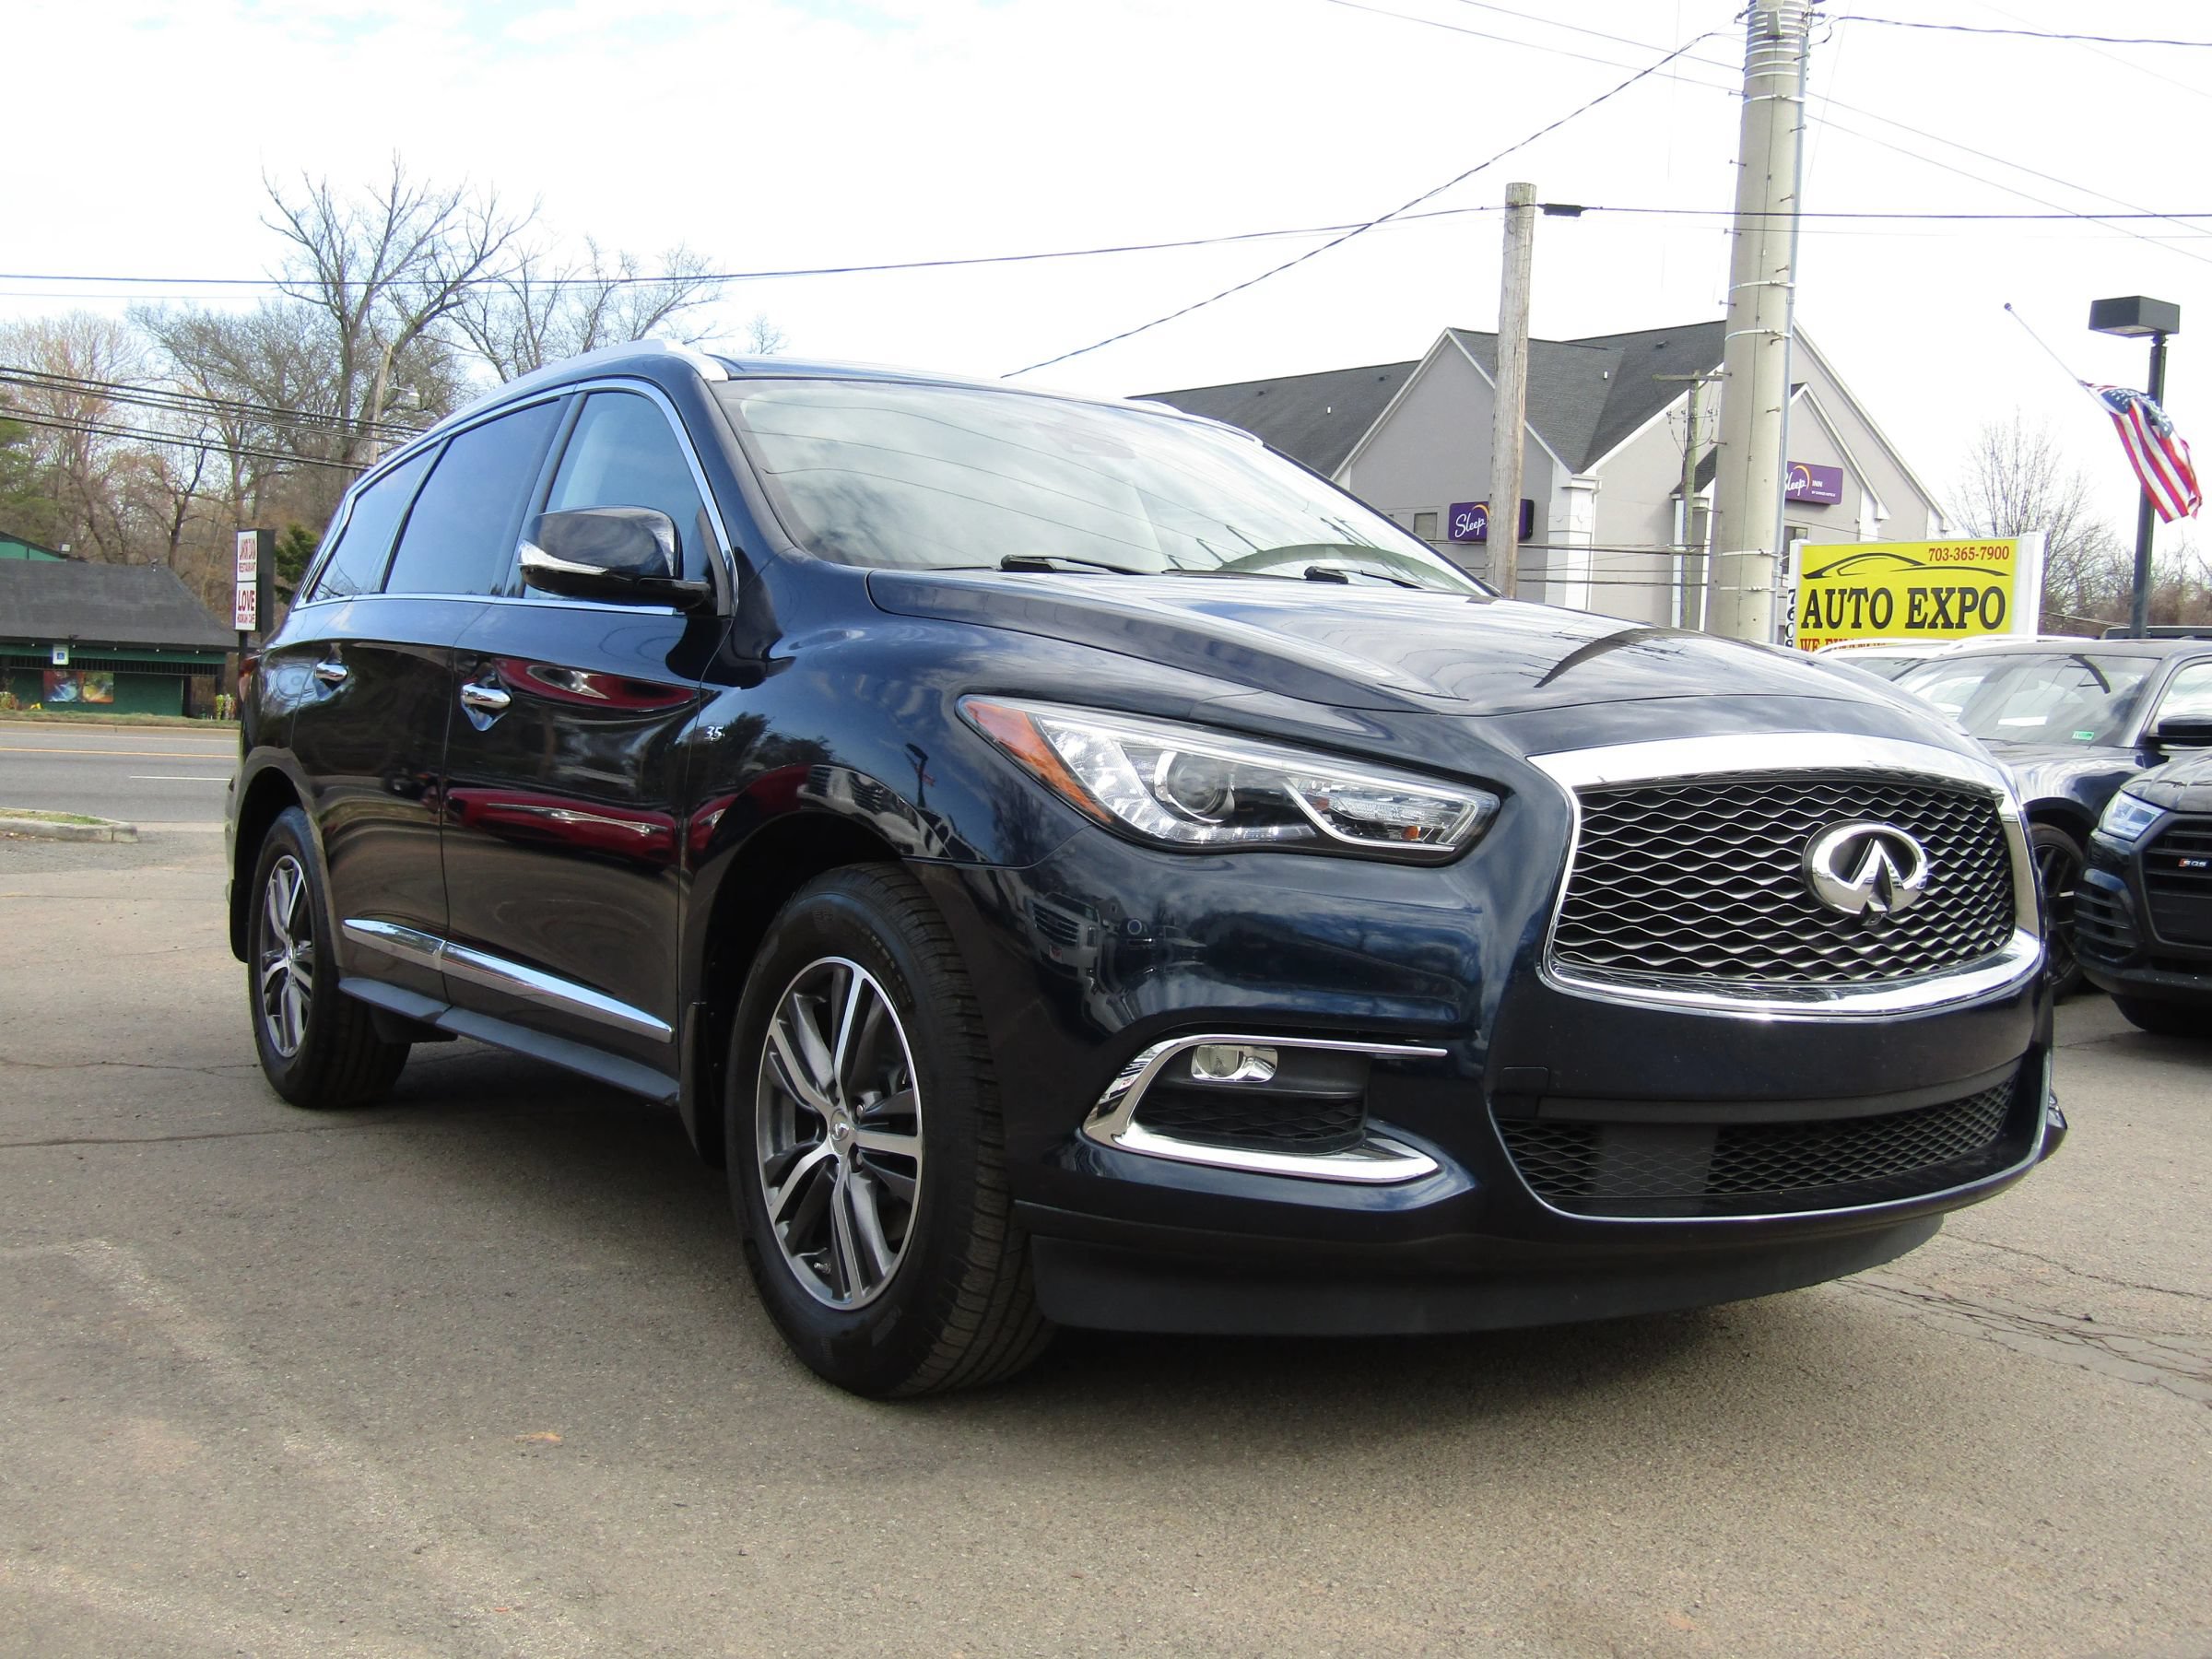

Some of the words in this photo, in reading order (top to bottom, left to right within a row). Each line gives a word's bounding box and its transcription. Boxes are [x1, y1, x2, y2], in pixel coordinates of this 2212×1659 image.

[1454, 512, 1486, 537] Sleep
[1928, 546, 2010, 561] 703-365-7900
[238, 590, 254, 611] LOVE
[1801, 587, 1894, 629] AUTO
[1904, 585, 2006, 629] EXPO
